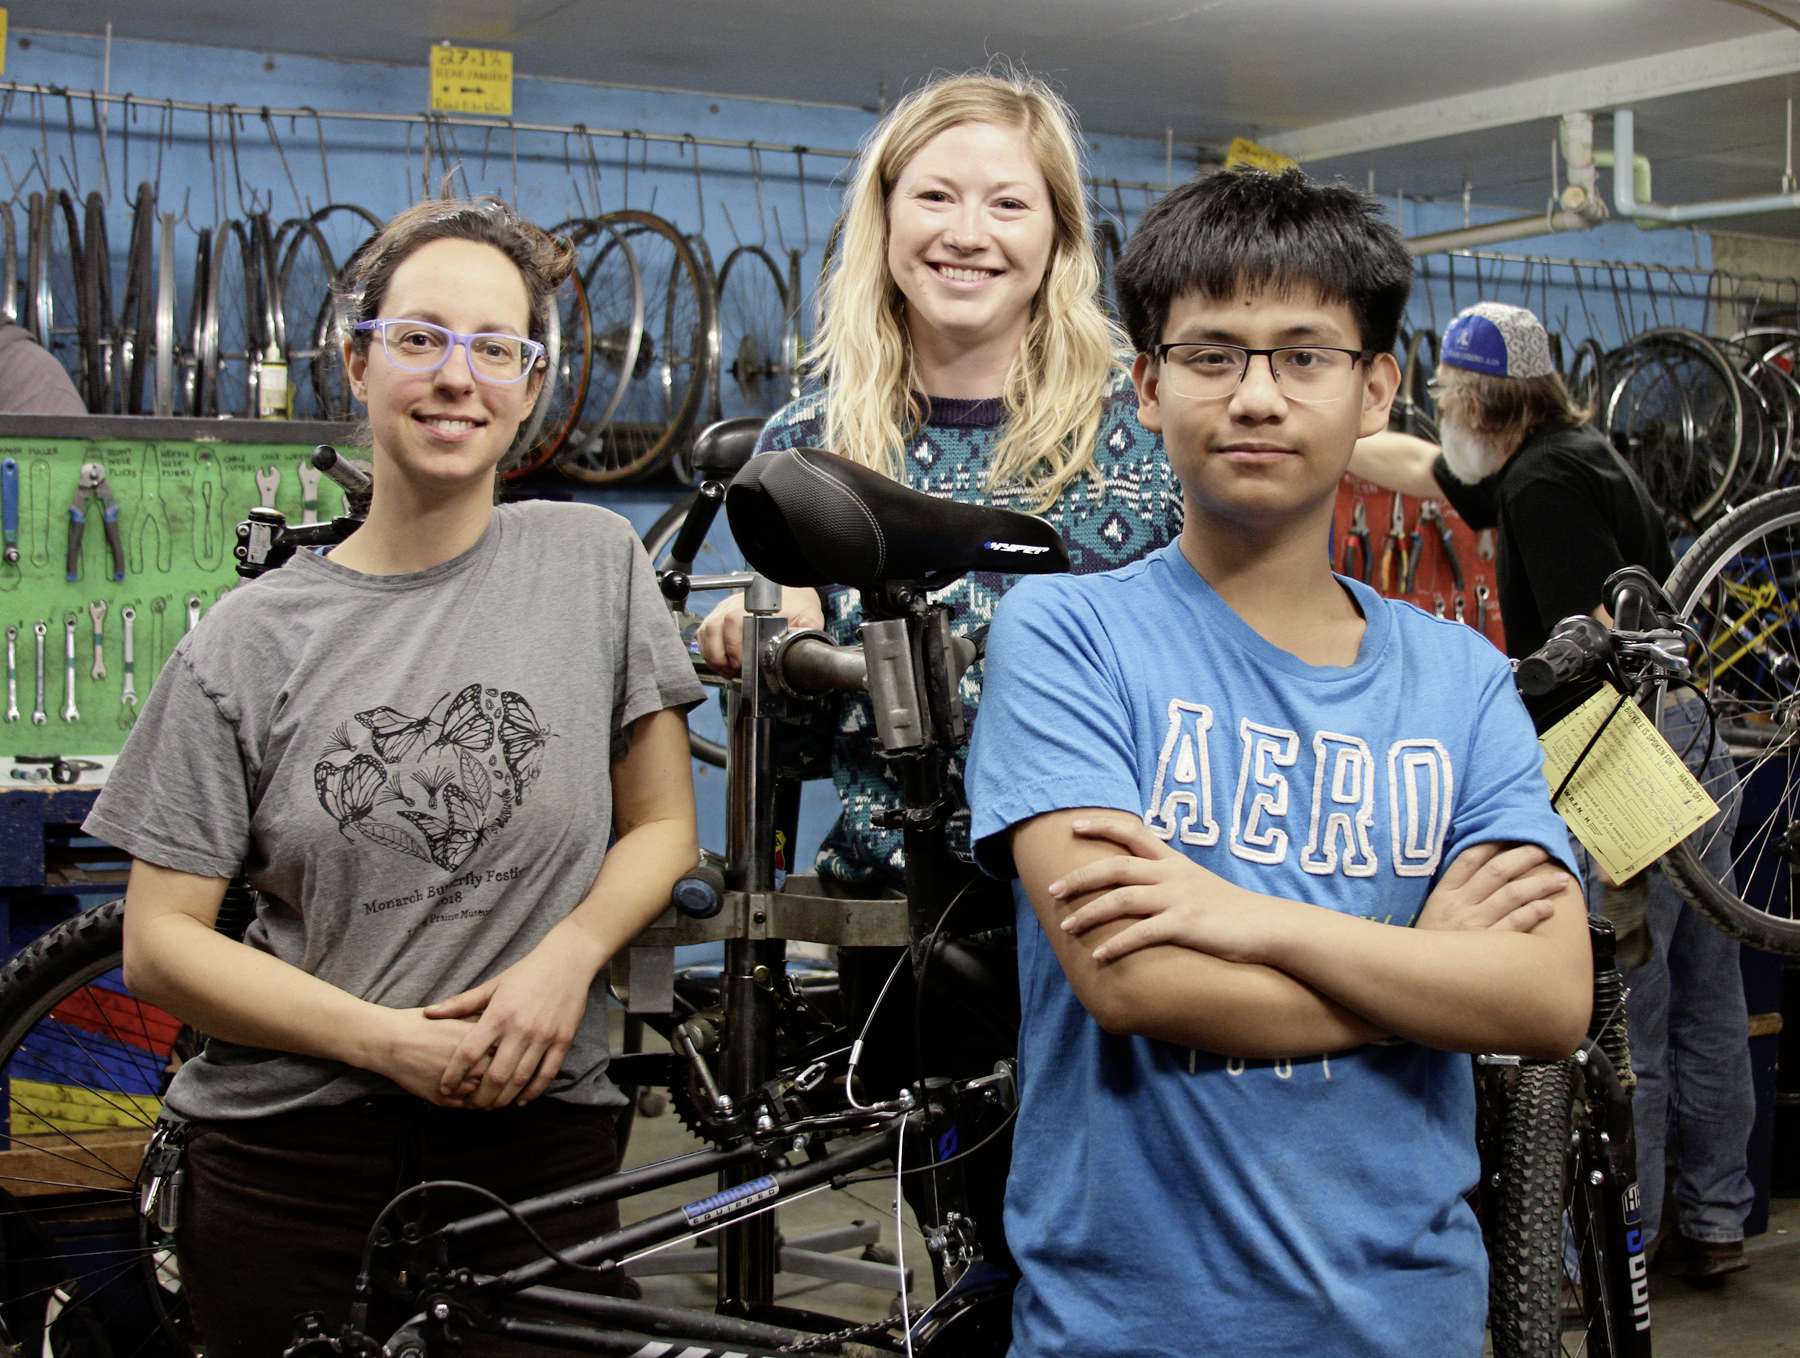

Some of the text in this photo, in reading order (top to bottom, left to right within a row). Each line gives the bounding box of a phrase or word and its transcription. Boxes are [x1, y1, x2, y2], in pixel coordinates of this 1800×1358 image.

[1622, 705, 1645, 730] BICYCLE
[1640, 726, 1651, 736] IS
[1644, 732, 1667, 756] SPOKEN
[1144, 698, 1453, 877] AERO
[363, 887, 424, 915] Monarch
[427, 870, 483, 898] Buerfly
[434, 892, 463, 907] 018
[693, 1189, 775, 1224] EQUIPPED
